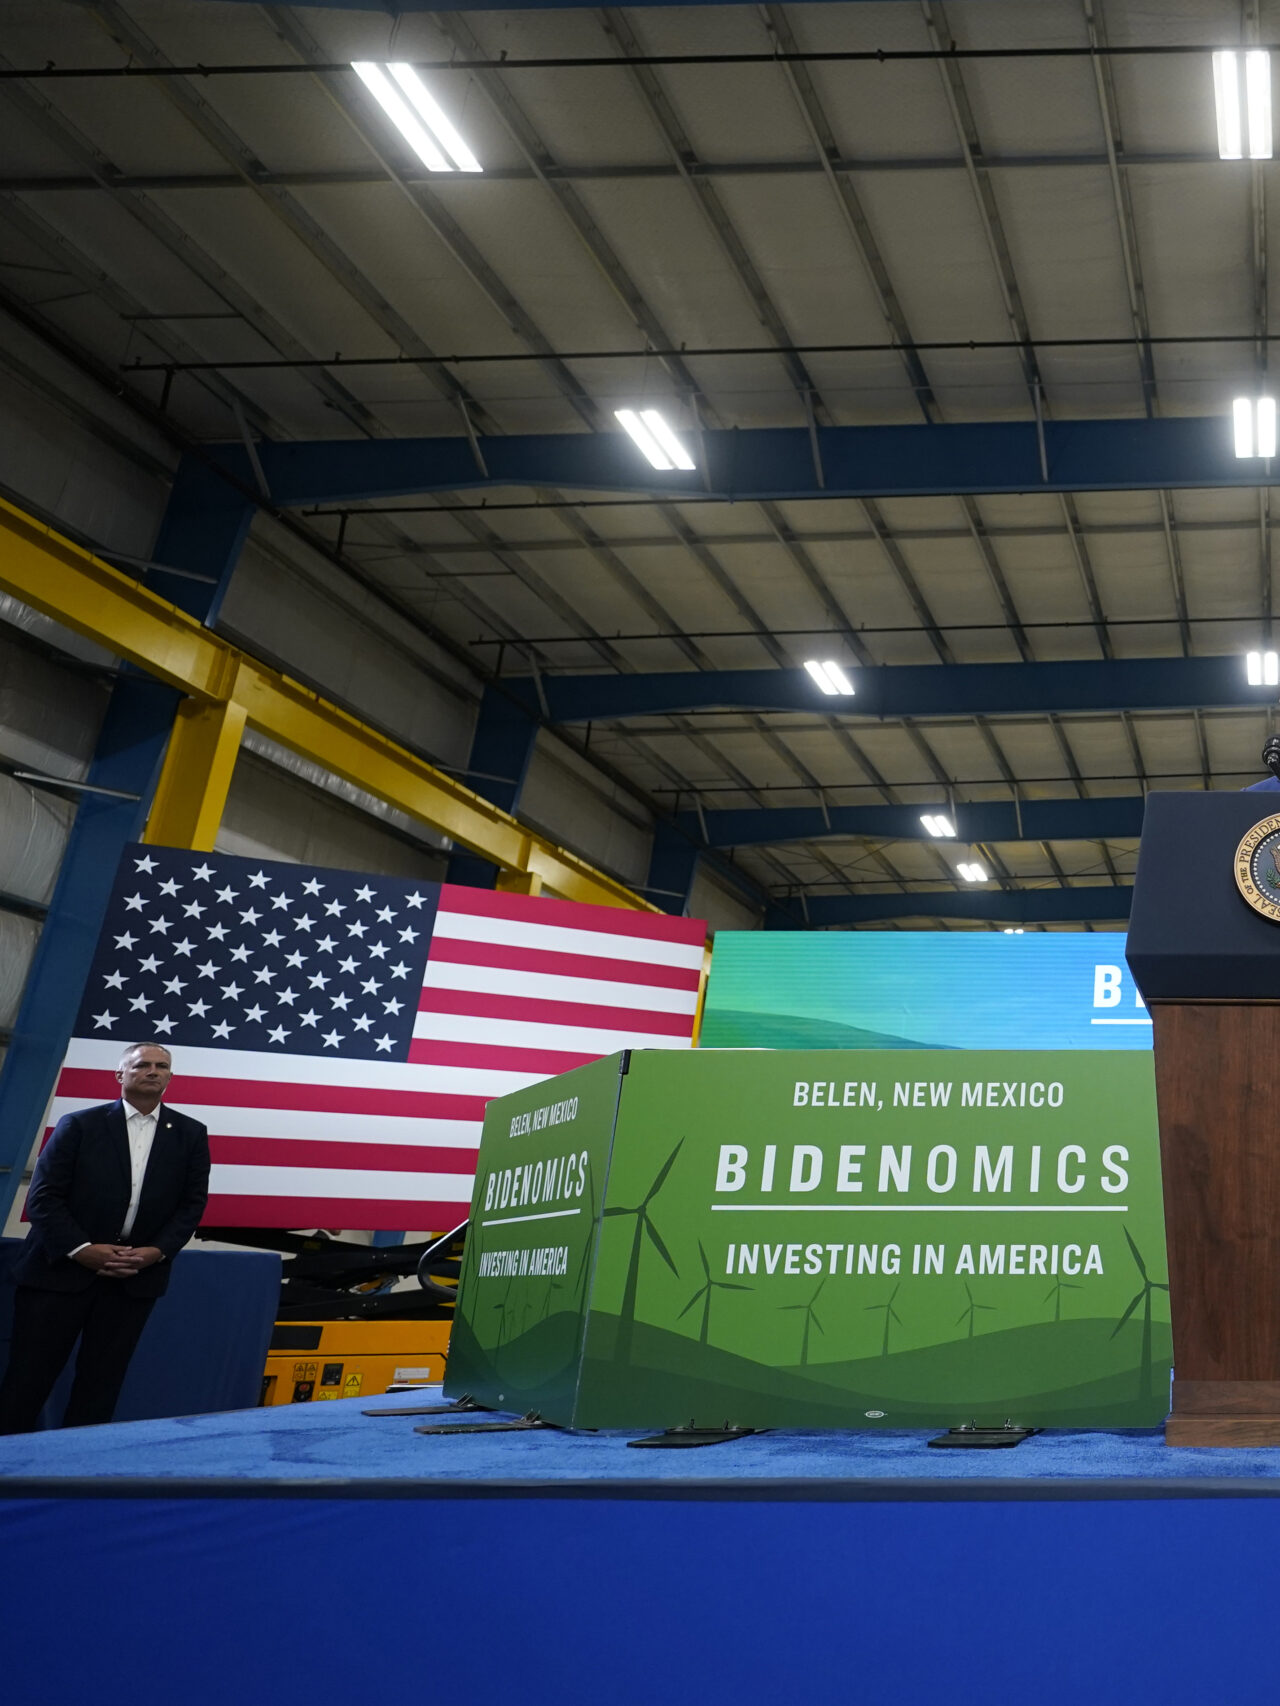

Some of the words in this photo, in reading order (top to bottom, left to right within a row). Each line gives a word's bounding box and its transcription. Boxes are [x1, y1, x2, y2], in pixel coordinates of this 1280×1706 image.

[1240, 867, 1249, 883] THE
[1244, 883, 1254, 895] OF
[793, 1081, 884, 1112] BELEN,
[893, 1081, 953, 1108] NEW
[960, 1081, 1064, 1108] MEXICO
[509, 1112, 532, 1138] BELEN,
[532, 1105, 550, 1132] NEW
[549, 1096, 579, 1126] MEXICO
[485, 1150, 588, 1212] BIDENOMICS
[714, 1144, 1131, 1194] BIDENOMICS
[478, 1249, 519, 1277] INVESTING
[519, 1249, 530, 1276] IN
[529, 1246, 568, 1277] AMERICA
[725, 1243, 901, 1275] INVESTING
[913, 1243, 946, 1275] IN
[954, 1243, 1105, 1276] AMERICA
